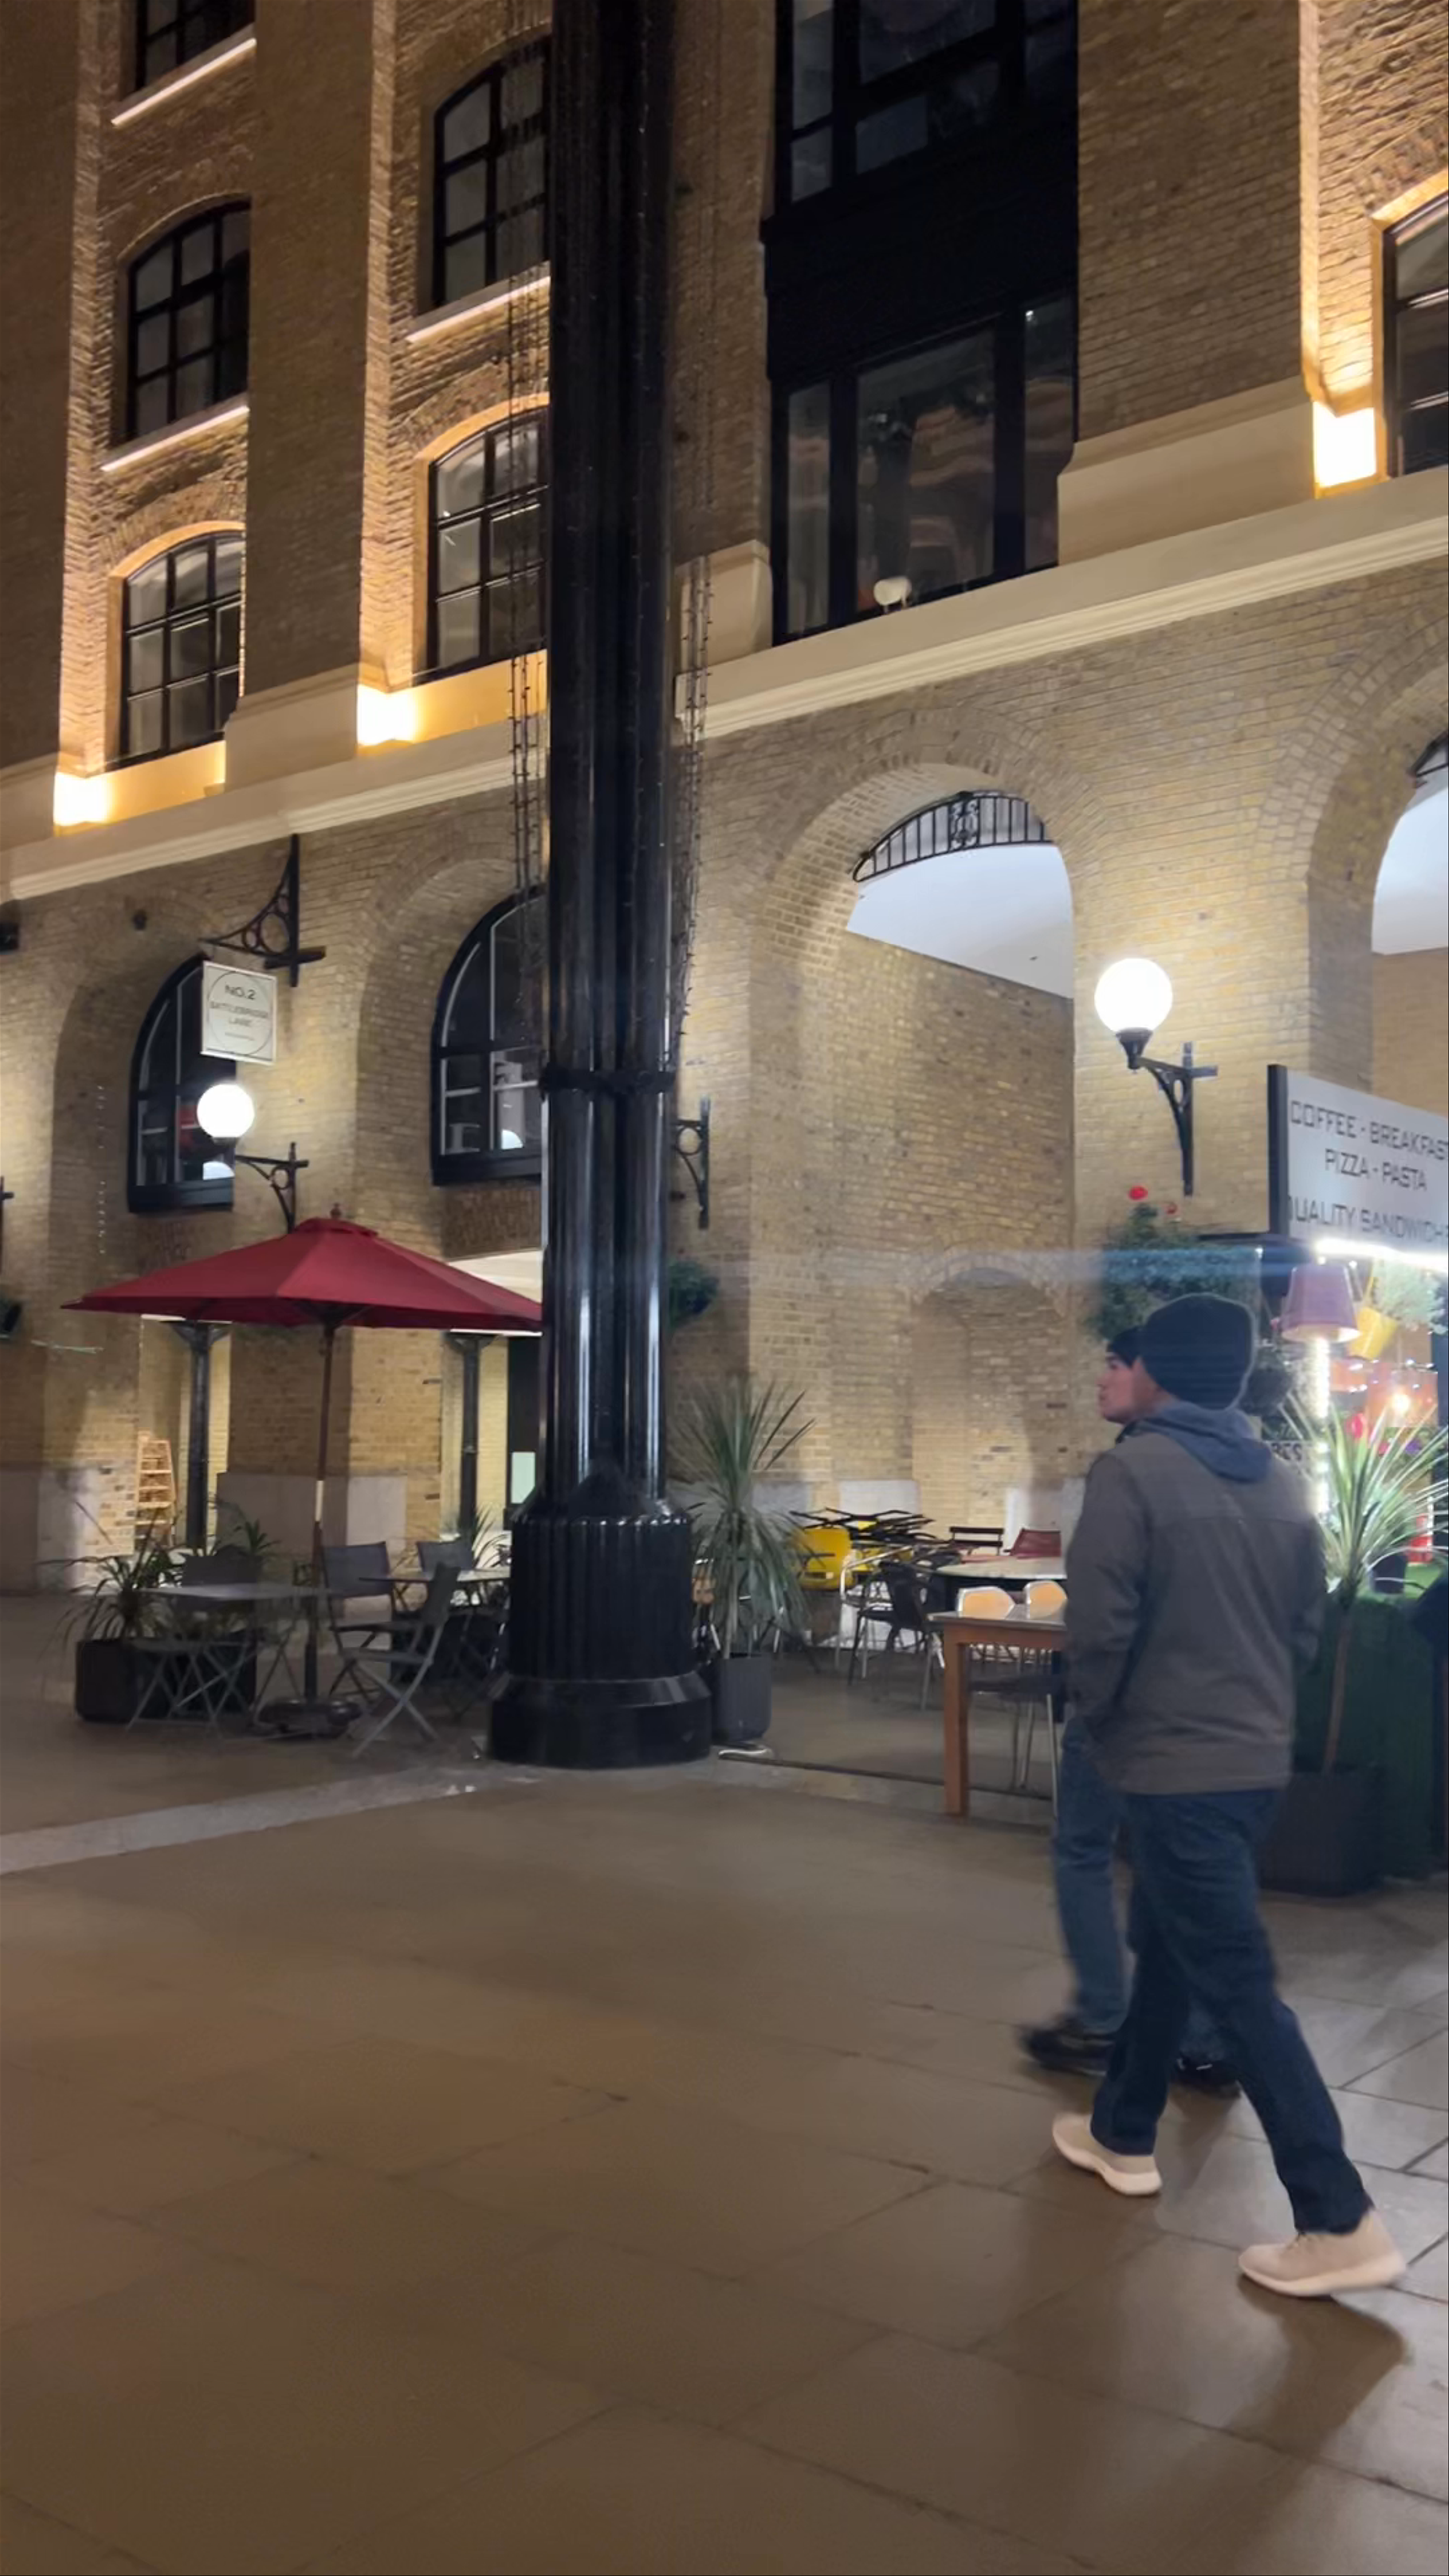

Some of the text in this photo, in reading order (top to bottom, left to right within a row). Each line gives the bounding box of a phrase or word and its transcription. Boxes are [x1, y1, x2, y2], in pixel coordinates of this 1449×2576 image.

[1291, 1100, 1357, 1139] COFFEE
[1325, 1148, 1428, 1192] PIZZA PASTA
